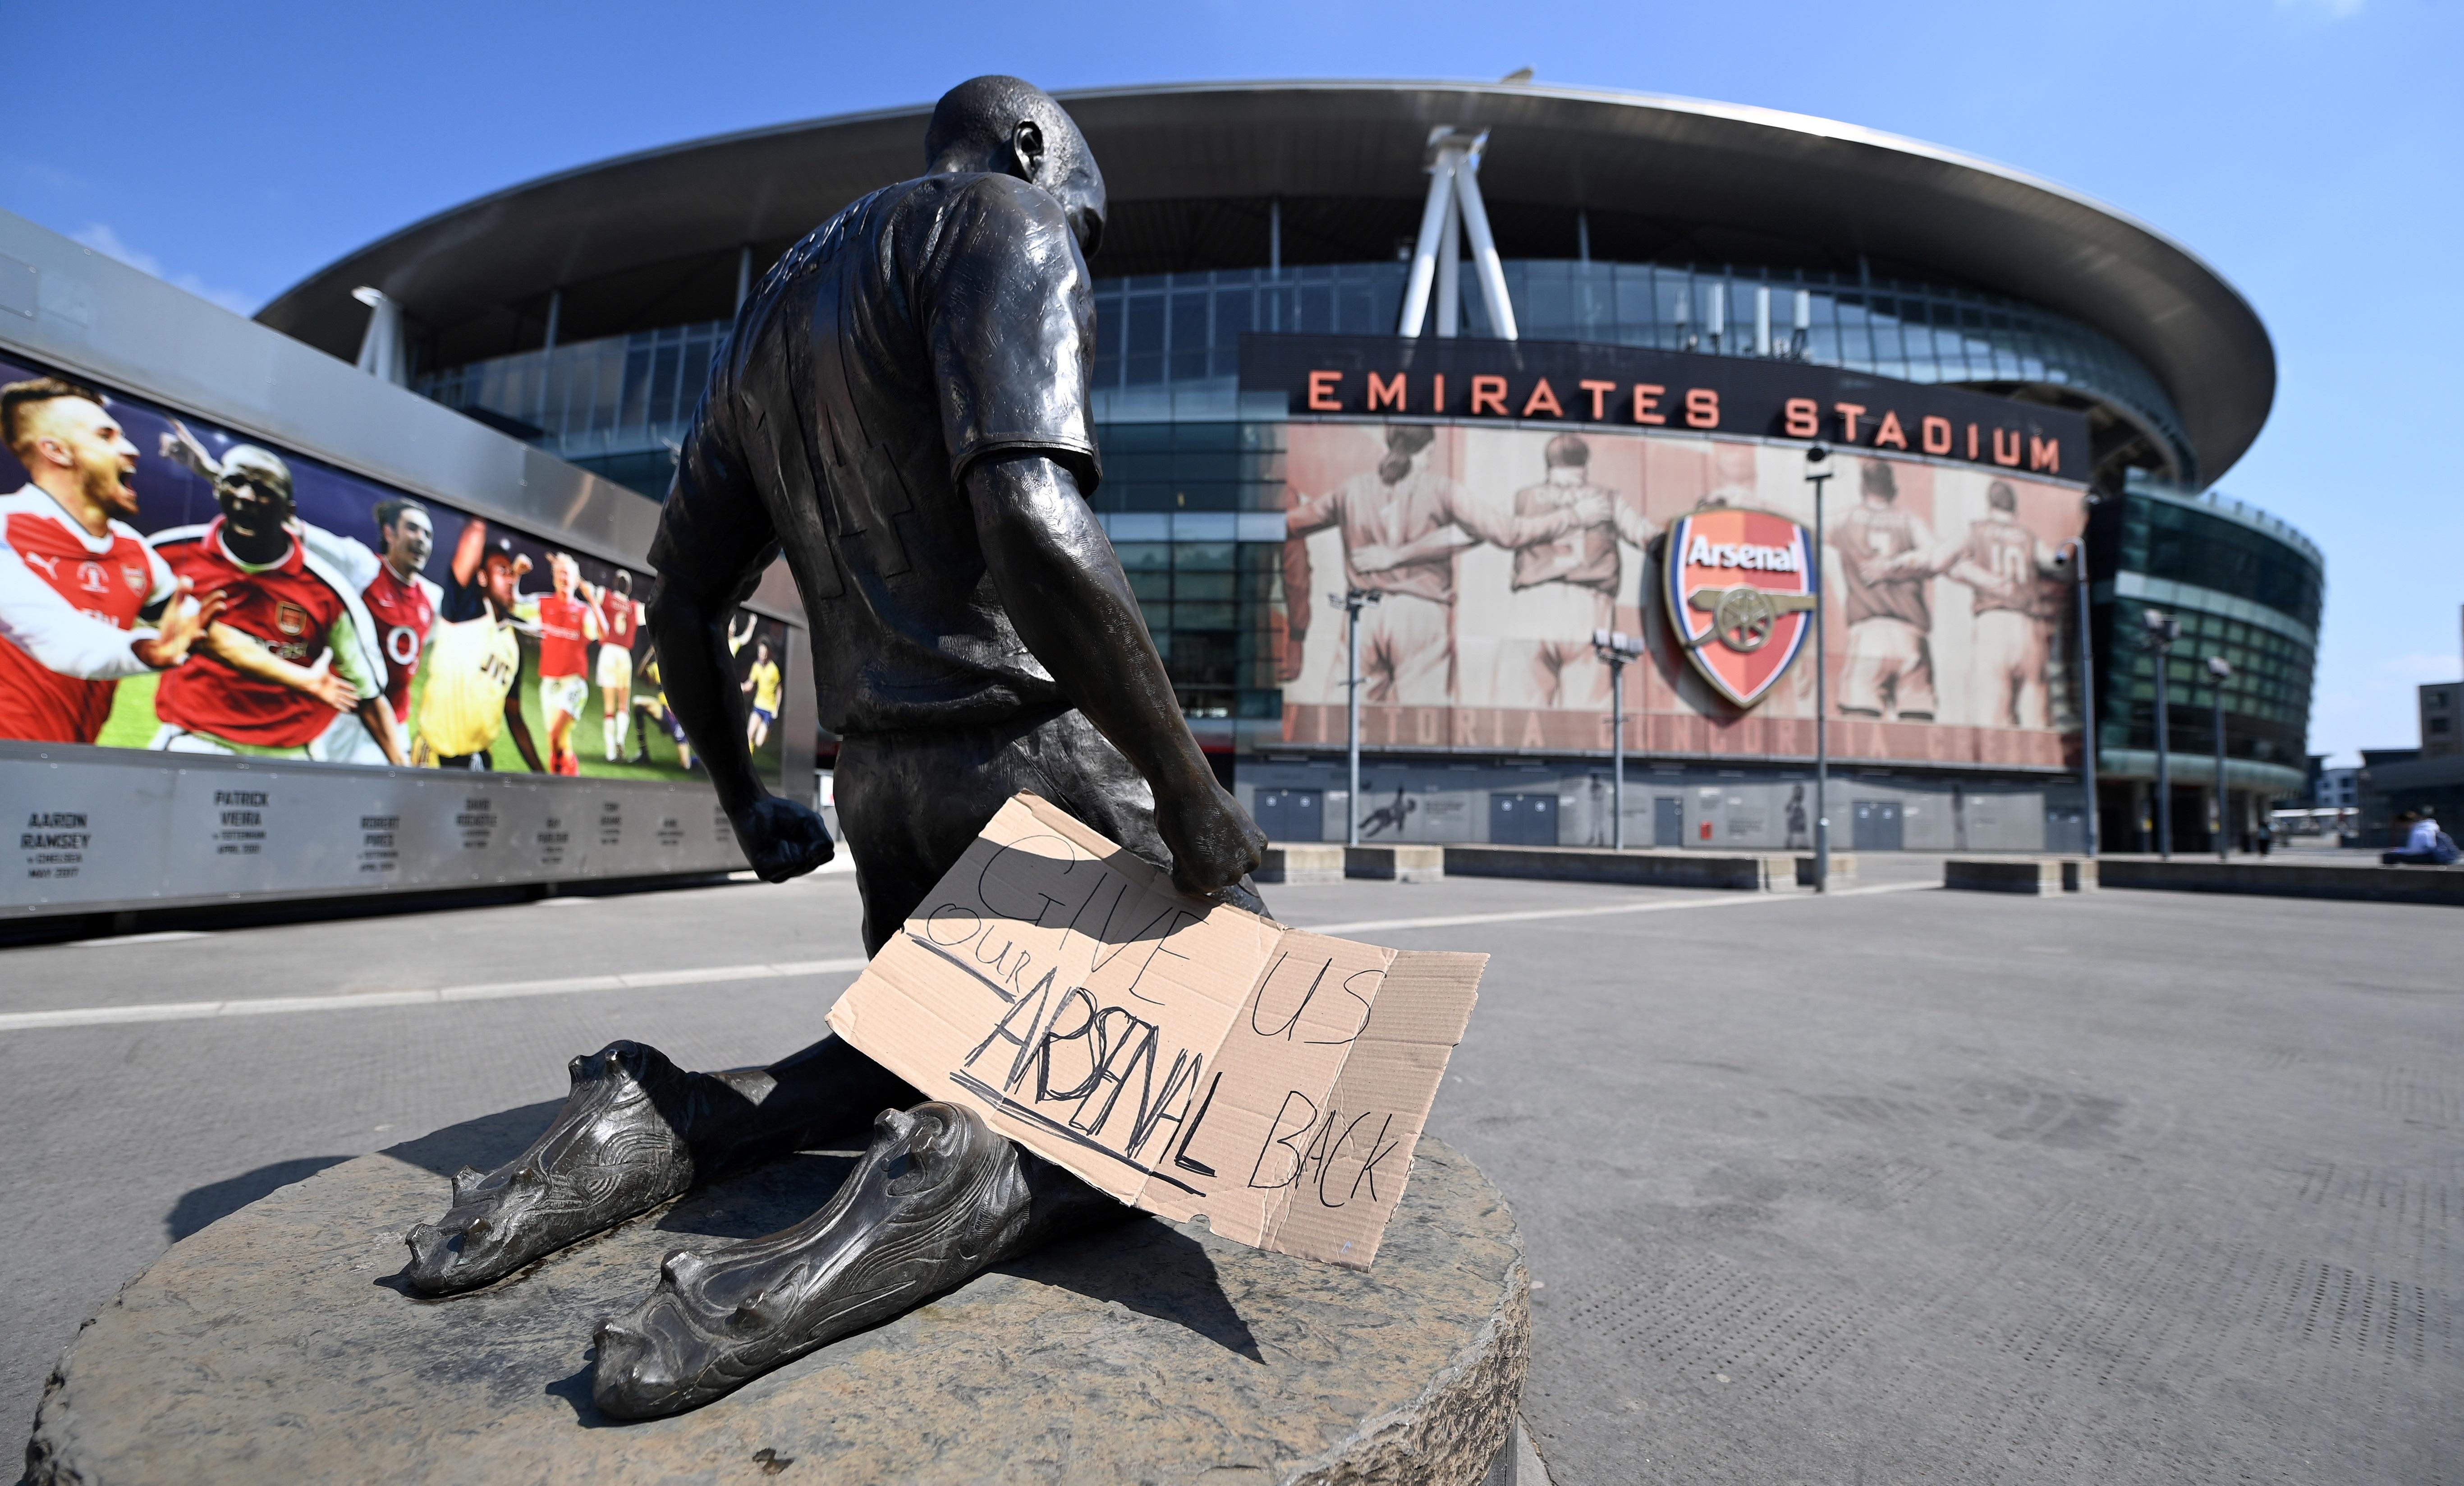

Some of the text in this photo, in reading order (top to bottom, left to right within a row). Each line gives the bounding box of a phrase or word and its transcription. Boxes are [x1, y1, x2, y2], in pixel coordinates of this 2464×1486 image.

[1308, 370, 2060, 474] EMIRATES STADIUM
[1686, 535, 1800, 573] Arsenal
[21, 833, 91, 850] RAMSEY
[28, 812, 87, 828] AARON
[927, 902, 1032, 994] OUR
[978, 834, 1388, 1045] GIVE US
[965, 966, 1399, 1208] ARSENAL BACK
